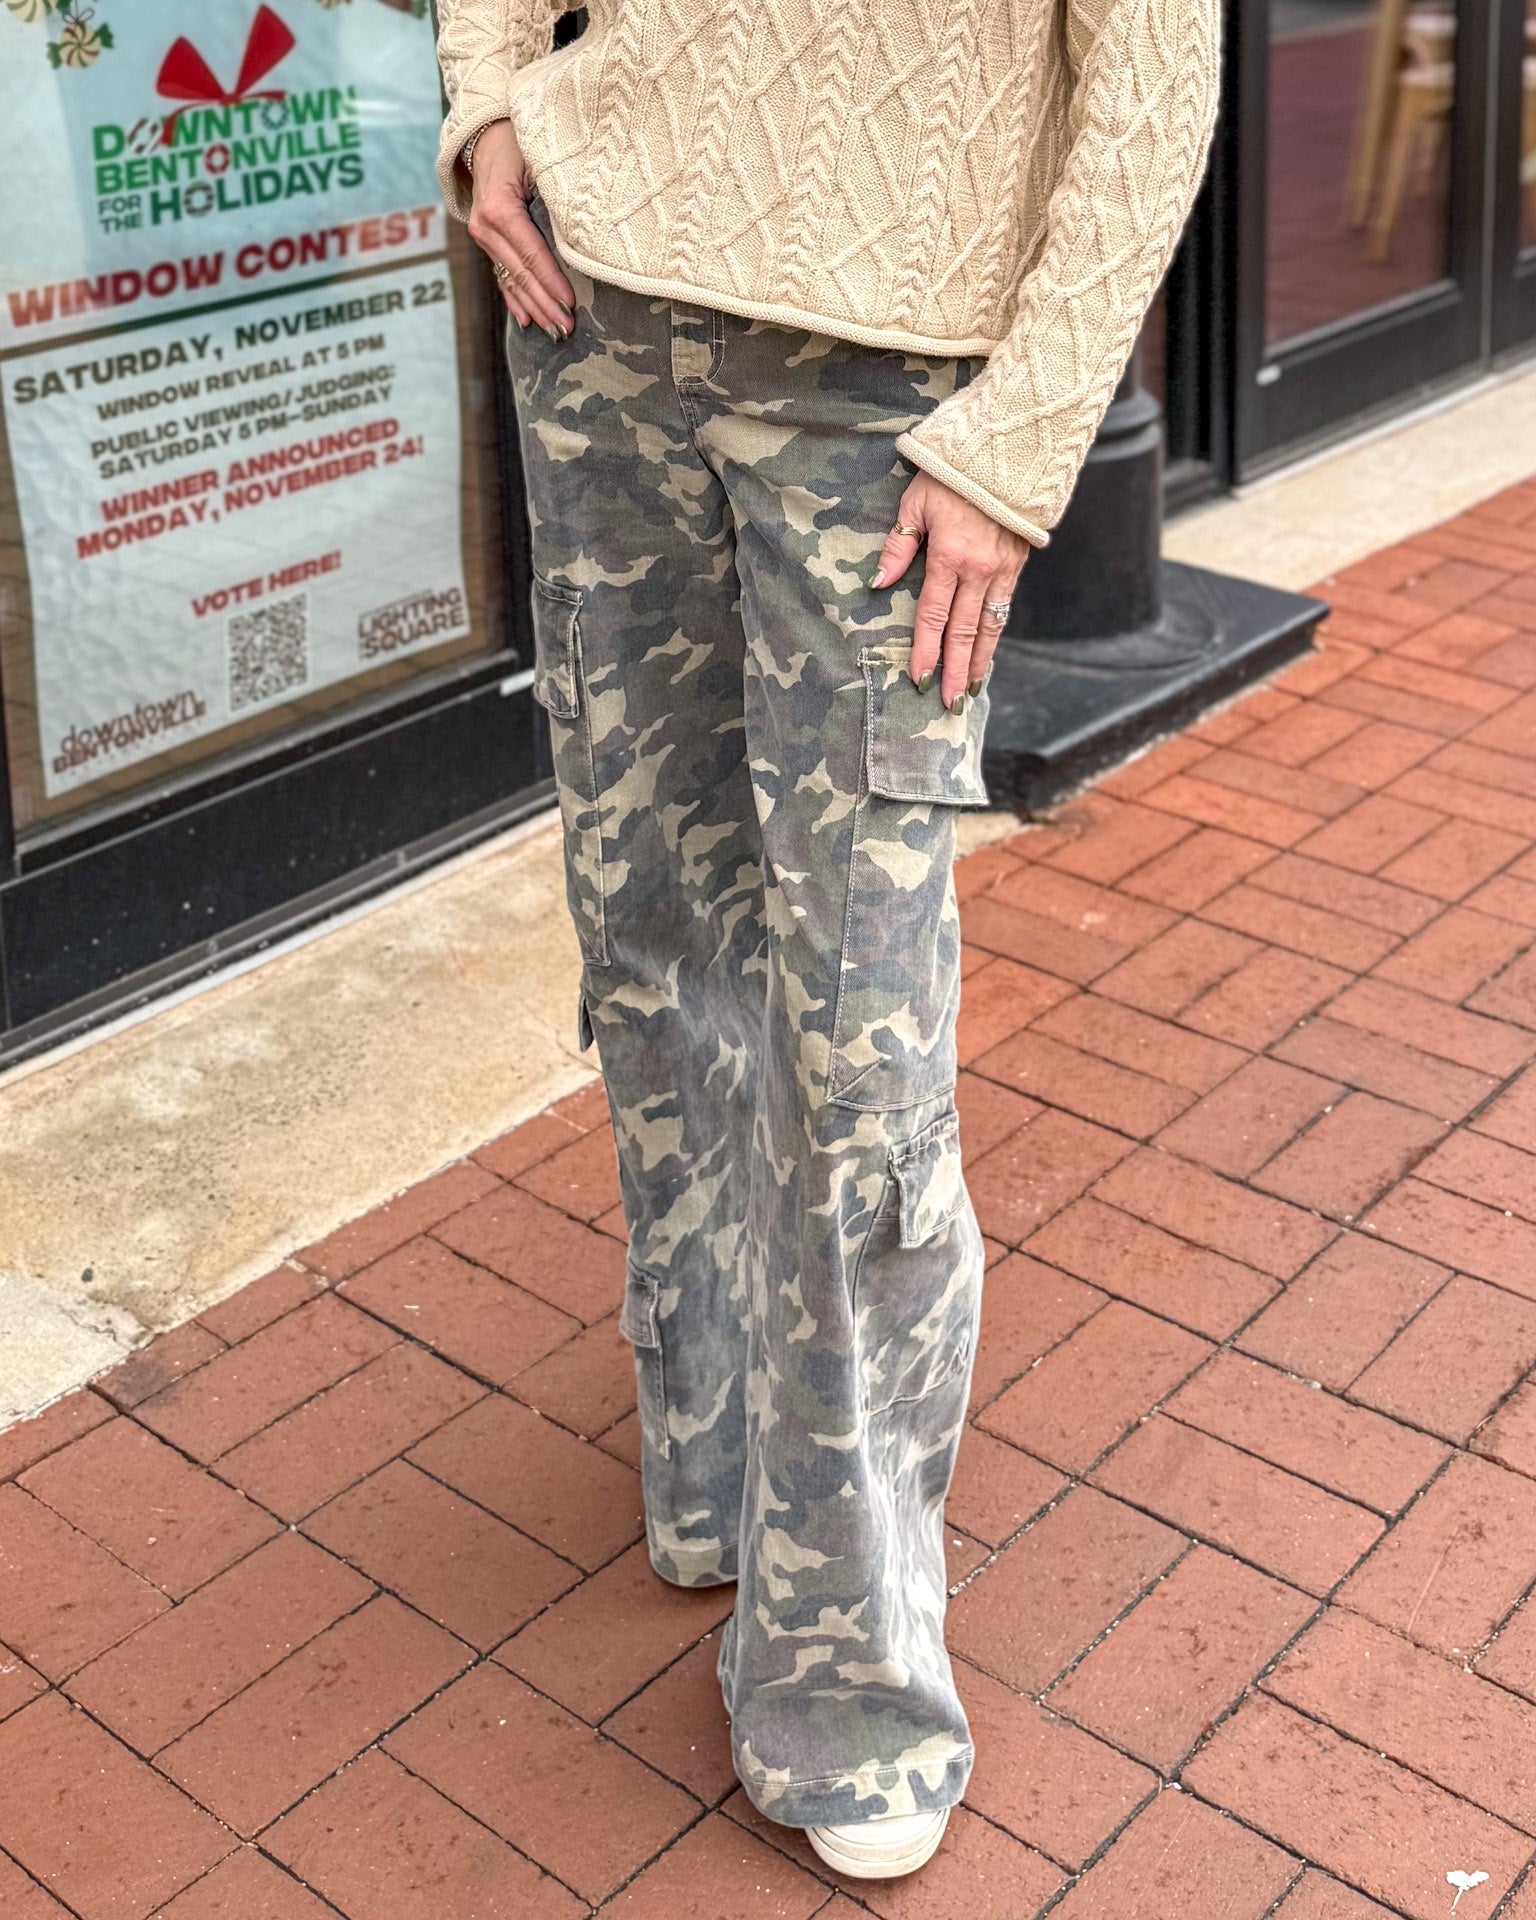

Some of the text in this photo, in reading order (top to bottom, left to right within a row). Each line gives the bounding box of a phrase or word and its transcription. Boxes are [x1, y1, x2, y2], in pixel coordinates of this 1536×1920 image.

[95, 122, 361, 196] BENTONVILLE
[152, 153, 365, 225] HOLIDAYS
[98, 193, 142, 215] FOR
[101, 212, 143, 233] THE
[7, 206, 438, 328] WINDOW CONTEST
[13, 280, 447, 402] SATURDAY, NOVEMBER 22
[97, 334, 385, 420] WINDOW REVEAL AT 5 PM
[91, 421, 180, 459] PUBLIC
[100, 428, 231, 479] SATURDAY
[238, 422, 251, 440] 5
[101, 418, 400, 522] WINNER ANNOUNCED
[76, 436, 424, 559] MONDAY, NOVEMBER 24!
[191, 551, 342, 618] VOTE HERE!
[359, 587, 461, 638] LIGHTING
[364, 606, 465, 658] SQUARE
[53, 701, 206, 774] BENTONVILLE
[60, 690, 197, 754] downtown
